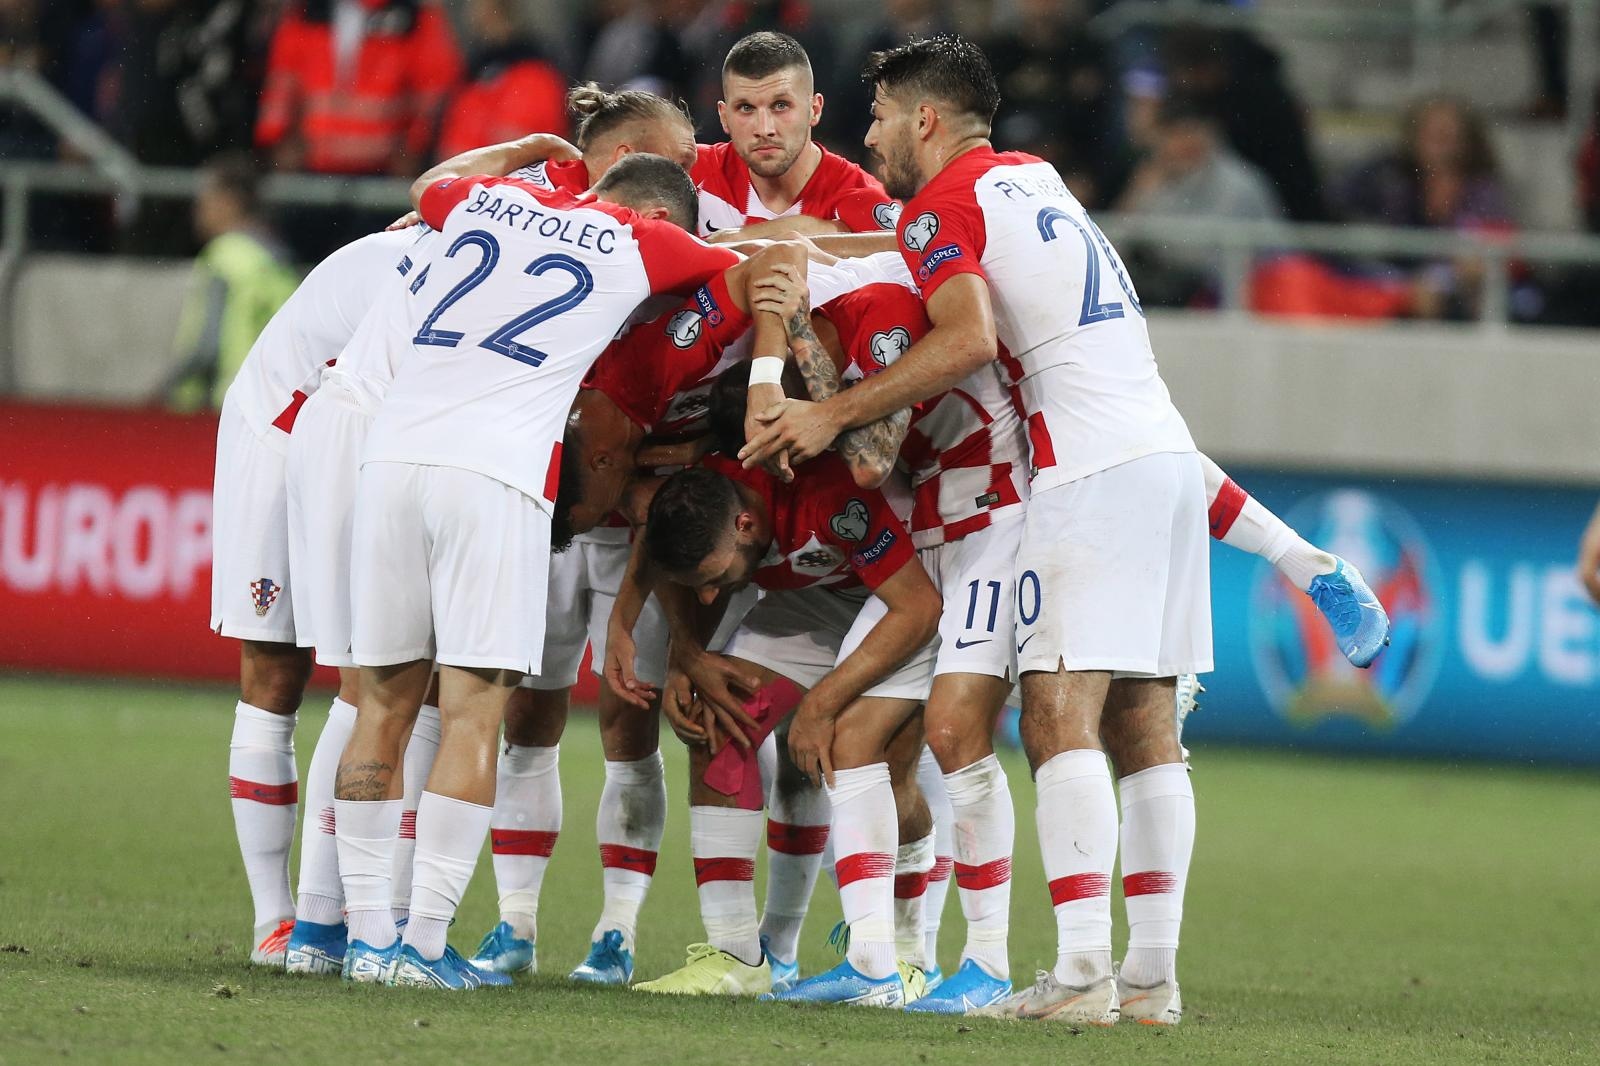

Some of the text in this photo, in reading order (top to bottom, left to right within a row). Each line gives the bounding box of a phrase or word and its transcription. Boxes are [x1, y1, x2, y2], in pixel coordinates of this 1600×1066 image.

[465, 190, 616, 254] BARTOLEC
[926, 247, 960, 270] RESPECT
[413, 230, 593, 367] 22
[863, 529, 893, 560] RESPECT
[967, 578, 1002, 633] 11
